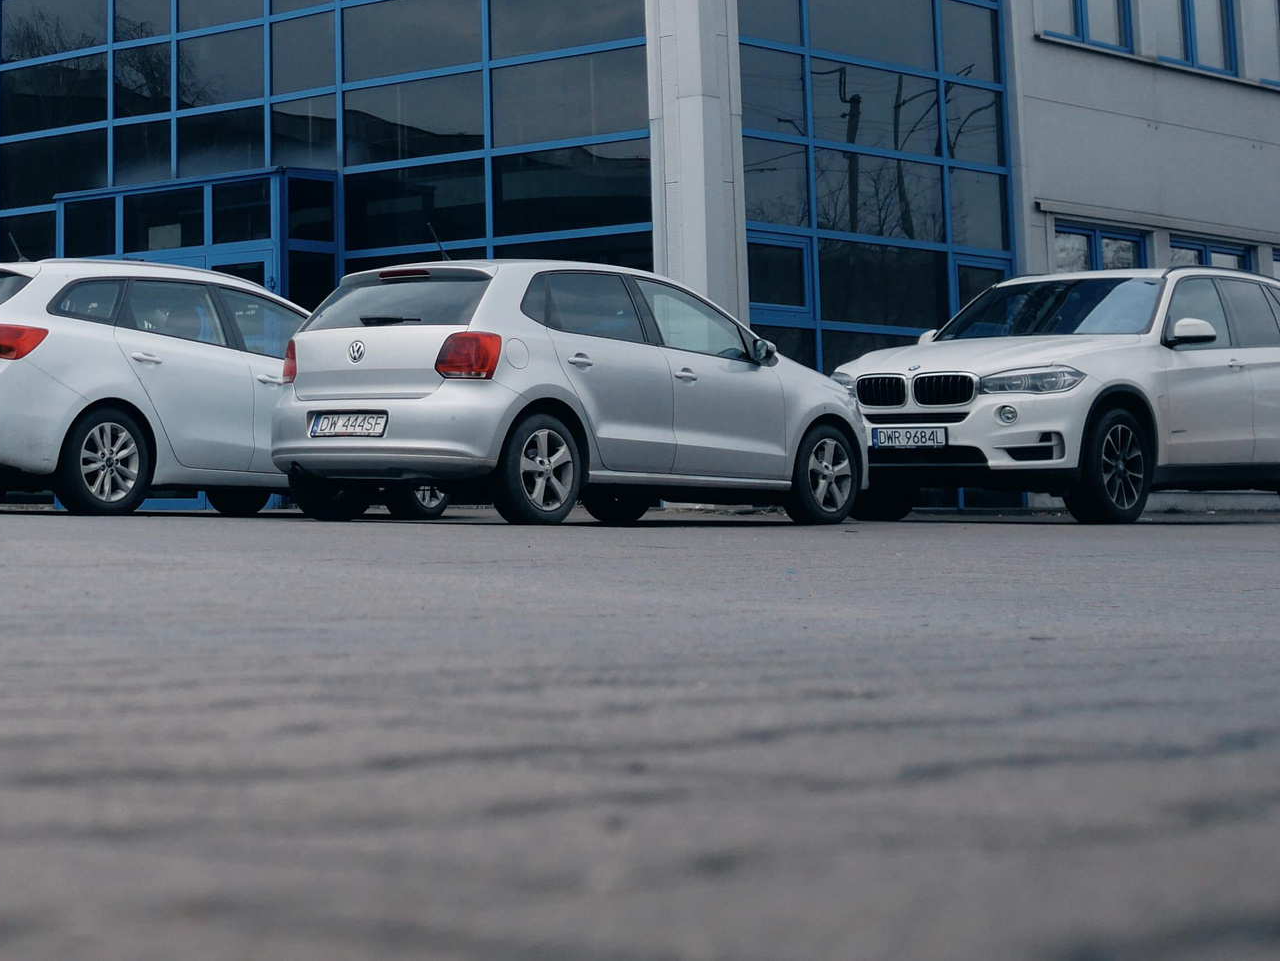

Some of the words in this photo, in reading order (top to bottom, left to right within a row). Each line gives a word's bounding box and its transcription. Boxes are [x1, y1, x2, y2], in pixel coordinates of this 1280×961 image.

[320, 417, 340, 431] DW
[342, 416, 384, 431] 444SF
[878, 430, 901, 445] DWR
[905, 430, 944, 445] 9684L
